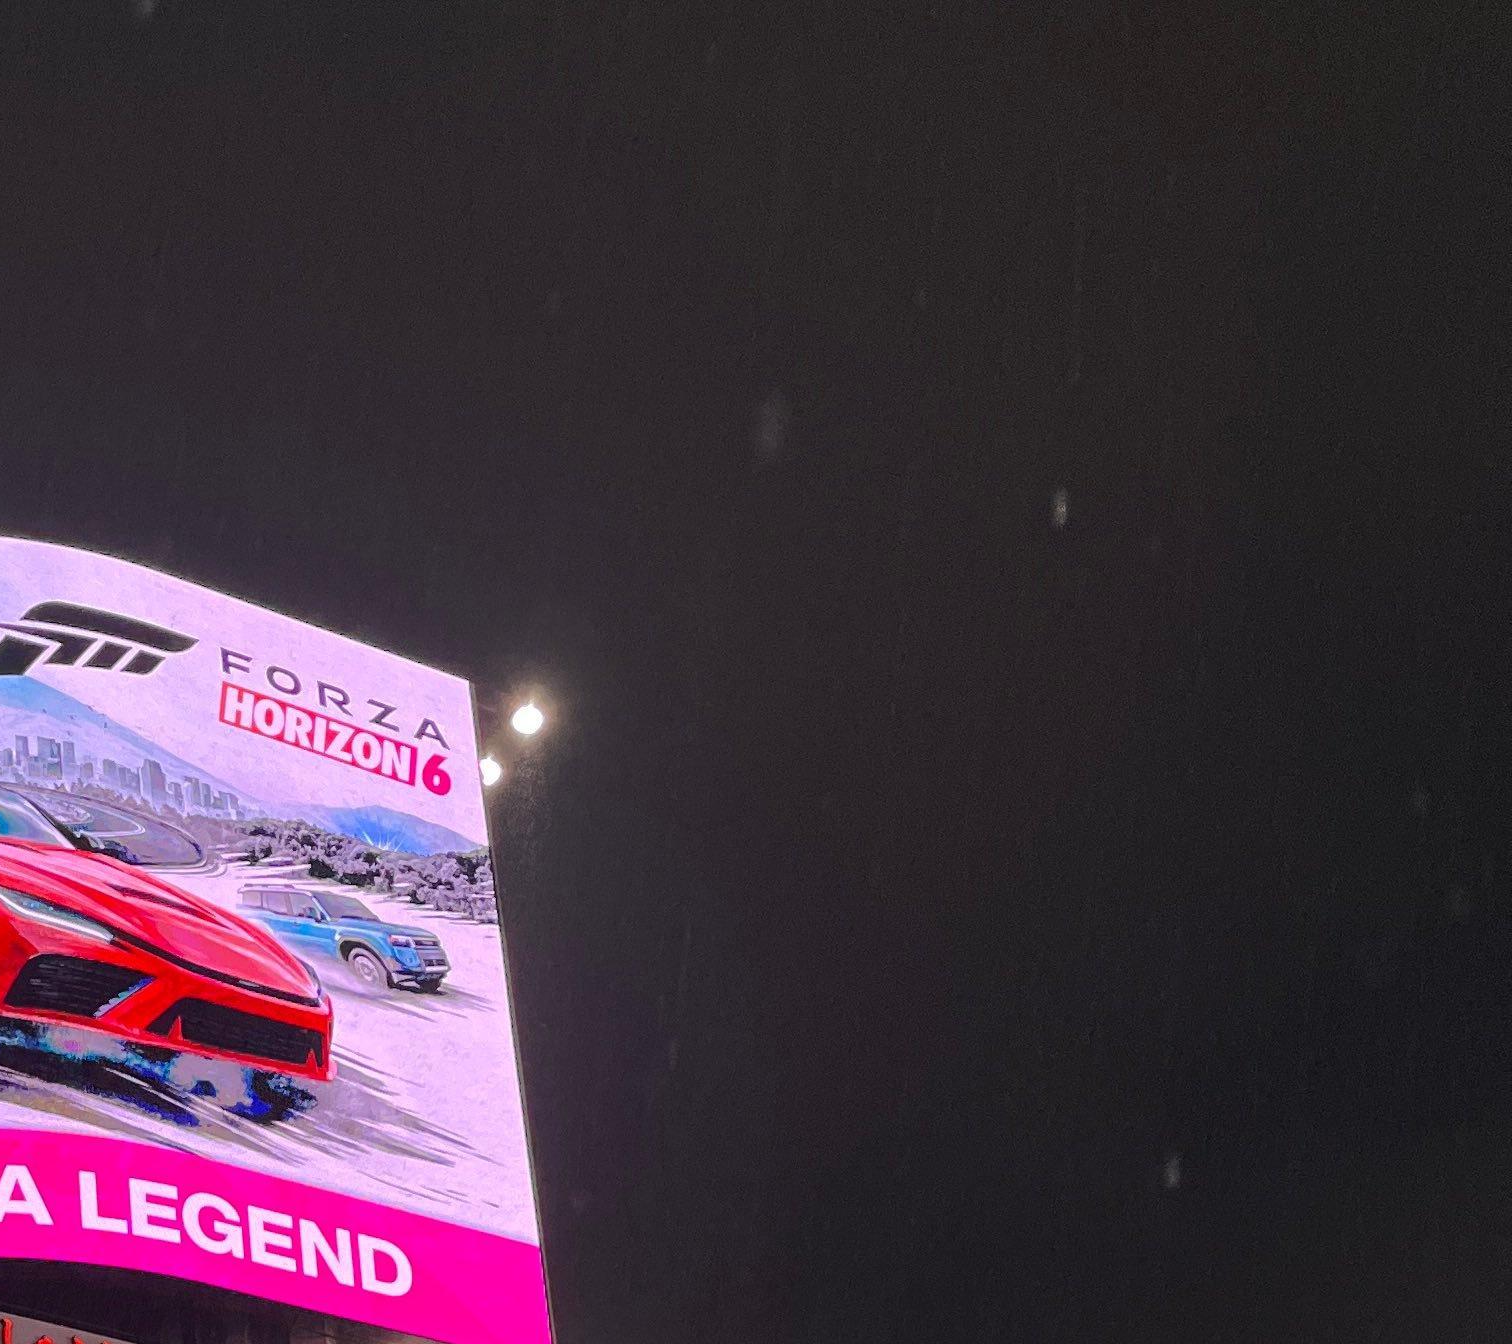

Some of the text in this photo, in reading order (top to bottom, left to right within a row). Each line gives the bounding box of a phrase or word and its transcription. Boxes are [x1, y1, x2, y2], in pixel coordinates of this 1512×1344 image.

[219, 647, 451, 750] FORZA
[223, 686, 453, 797] HORIZON 6
[77, 1170, 415, 1298] LEGEND
